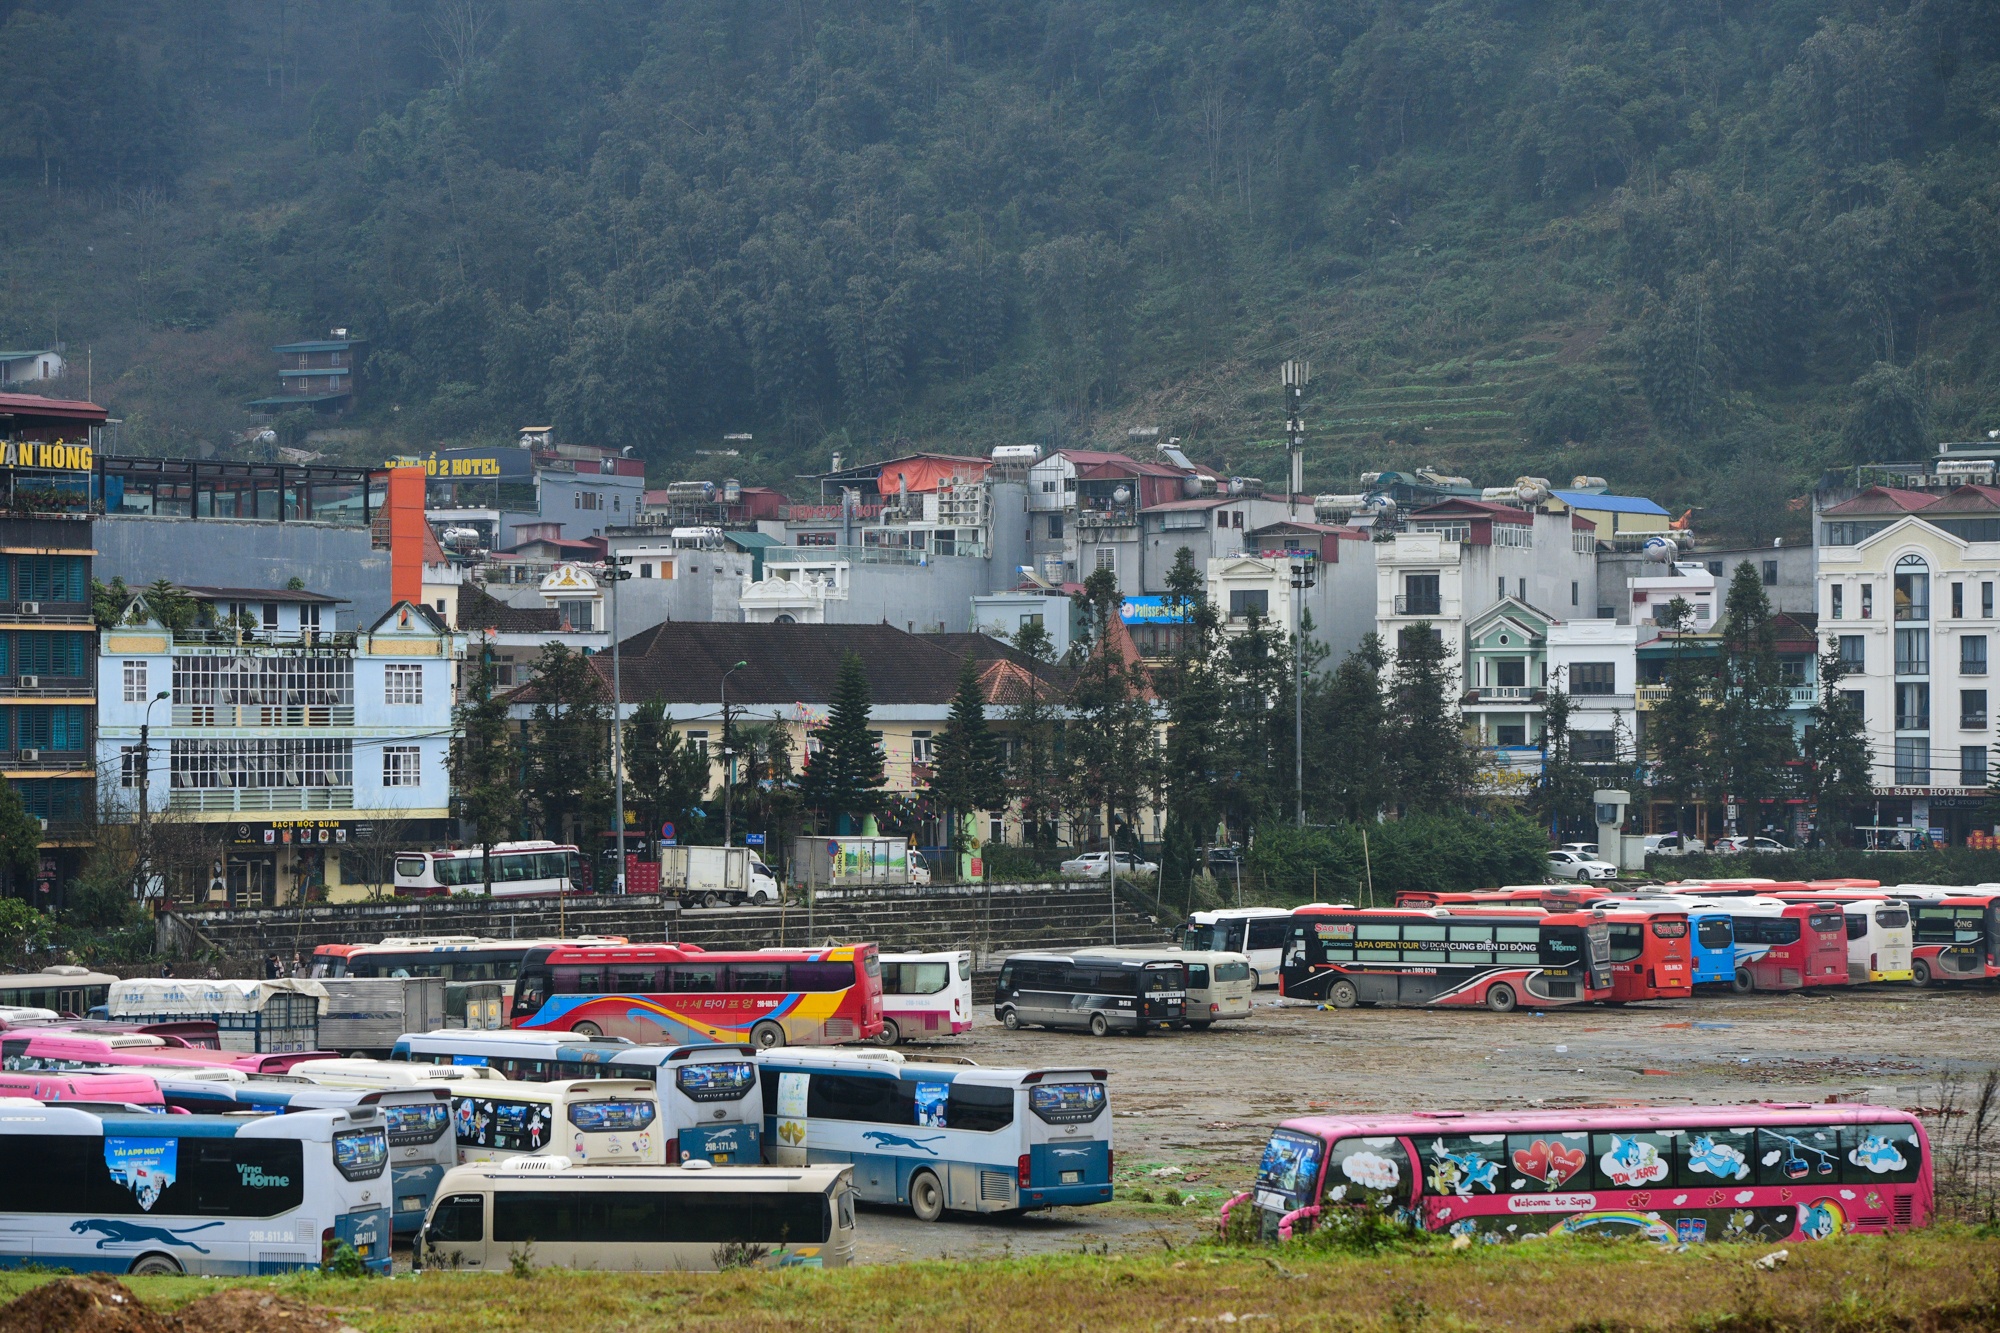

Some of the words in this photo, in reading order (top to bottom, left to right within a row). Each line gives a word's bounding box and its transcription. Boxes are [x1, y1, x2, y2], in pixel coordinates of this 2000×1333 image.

[40, 438, 92, 470] HỒNG
[440, 459, 449, 475] 2
[452, 459, 500, 475] HOTEL
[272, 821, 294, 830] BẠCH
[297, 819, 314, 829] MỘC
[318, 819, 339, 829] QUÁN
[1315, 923, 1335, 932] SAO
[1657, 925, 1672, 934] SAO
[1375, 942, 1397, 950] OPEN
[1397, 942, 1419, 951] TOUR
[1450, 943, 1475, 951] CUNG
[1500, 943, 1509, 951] DI
[1510, 942, 1537, 952] ĐỘNG
[690, 1000, 702, 1009] 세
[704, 1000, 726, 1009] 타이
[728, 1000, 739, 1008] 프
[388, 1135, 434, 1144] UNIVERSE
[114, 1147, 126, 1157] TẢI
[127, 1149, 143, 1157] APP
[144, 1148, 165, 1156] NGAY
[705, 1142, 738, 1152] 29B-171.94
[1525, 1160, 1538, 1170] Love
[1554, 1156, 1578, 1168] Forever
[236, 1164, 262, 1174] Vina
[350, 1168, 381, 1178] UNIVERSE
[1612, 1173, 1631, 1184] TOM
[1634, 1165, 1660, 1180] JERRY
[242, 1173, 290, 1187] Home
[1514, 1198, 1551, 1207] Welcome
[1556, 1197, 1567, 1206] to
[1570, 1197, 1591, 1208] Sapa
